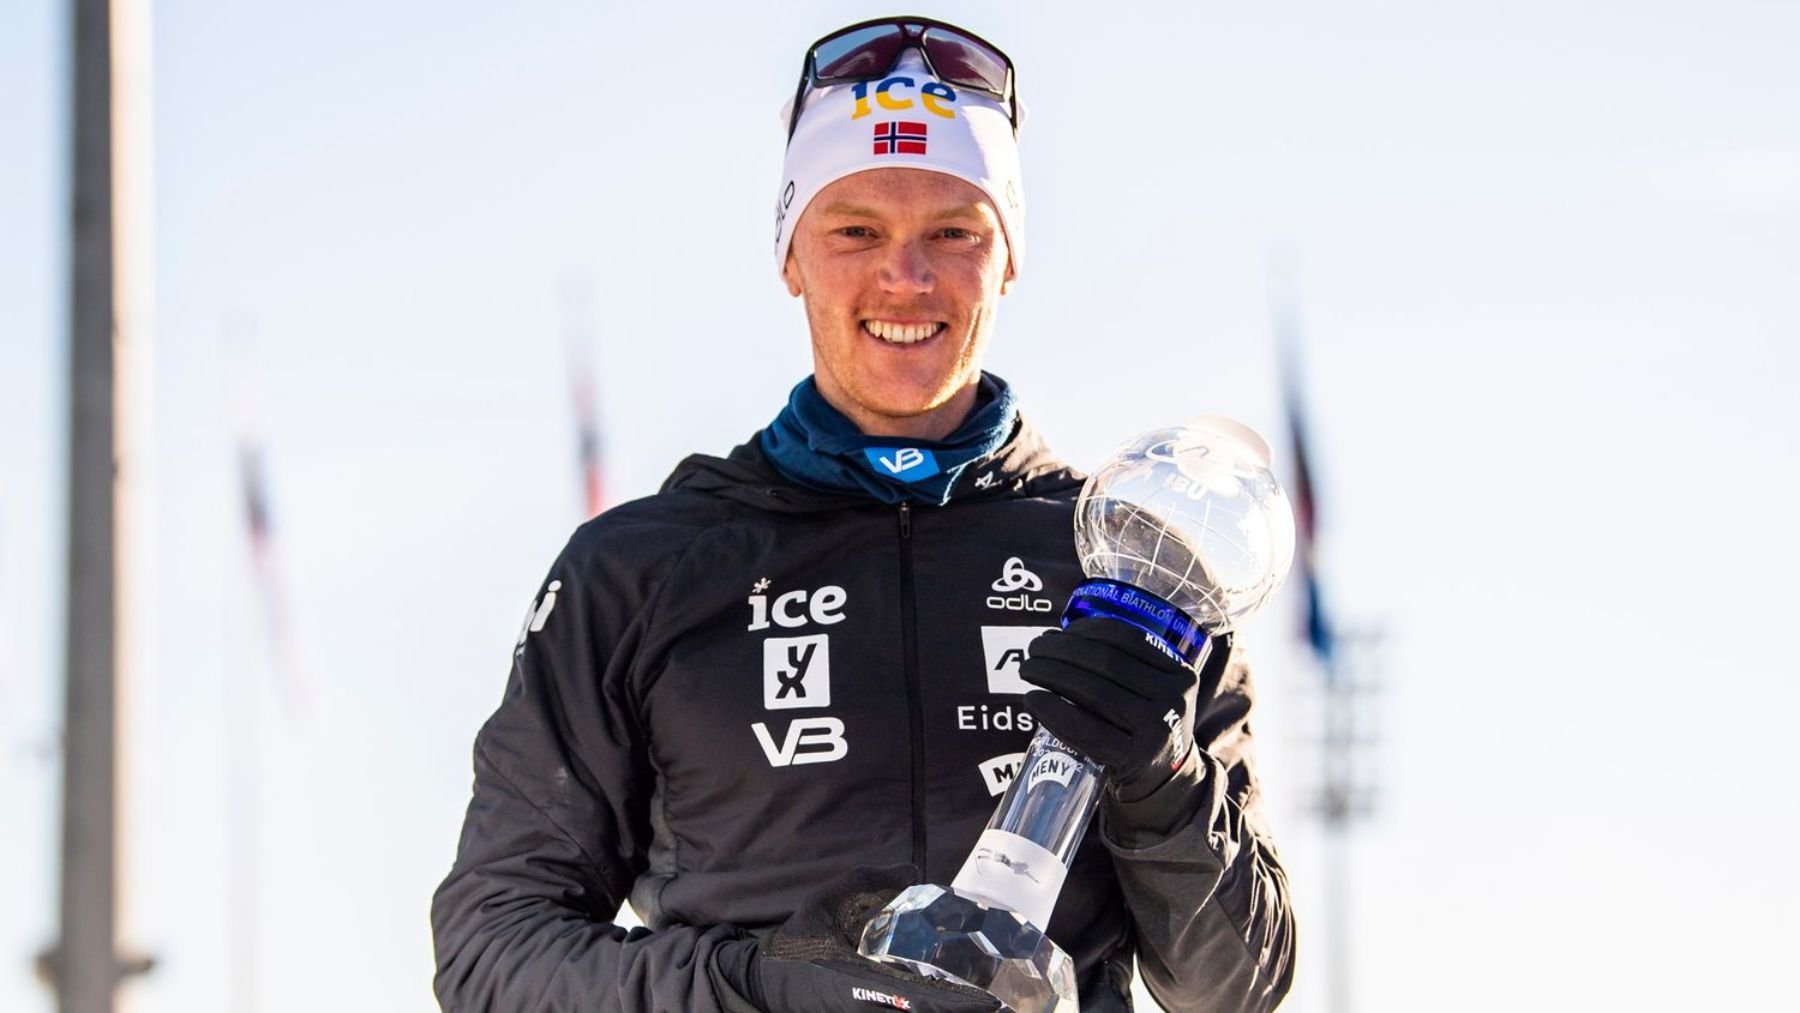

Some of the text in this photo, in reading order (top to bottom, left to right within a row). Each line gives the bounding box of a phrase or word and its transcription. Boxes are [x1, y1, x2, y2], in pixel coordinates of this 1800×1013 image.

[851, 76, 956, 120] ice
[880, 448, 924, 473] VB
[748, 577, 848, 631] ice
[985, 594, 1052, 612] odlo
[1121, 592, 1174, 622] BIATHLON
[957, 705, 1034, 731] Eids
[751, 717, 848, 767] VB
[1032, 758, 1071, 782] MENY
